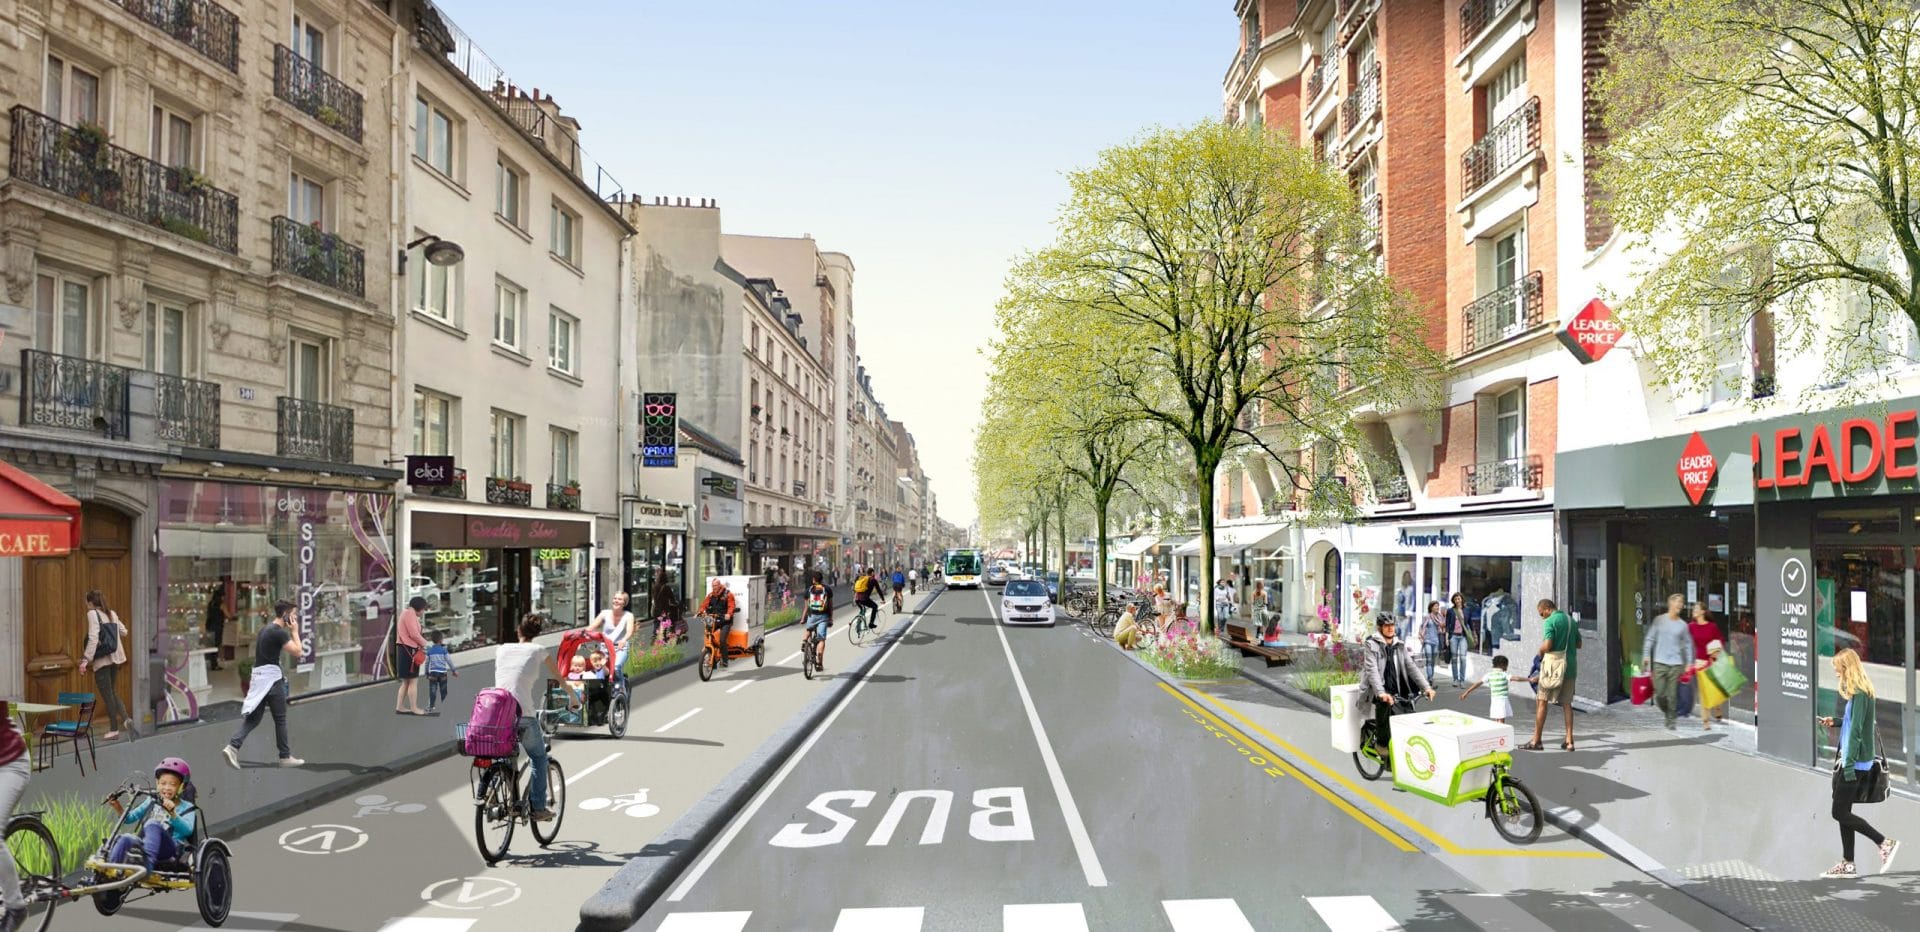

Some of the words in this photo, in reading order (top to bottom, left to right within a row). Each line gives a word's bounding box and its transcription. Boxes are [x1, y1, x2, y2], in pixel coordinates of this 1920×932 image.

[1578, 332, 1615, 344] PRICE
[1680, 455, 1713, 470] LEADER
[415, 462, 444, 478] eliot
[1683, 471, 1709, 485] PRICE
[278, 490, 306, 513] eliot
[471, 520, 520, 542] Quality
[527, 521, 558, 538] Shoes
[0, 533, 51, 553] CAFE
[436, 549, 481, 563] SOLDES
[539, 548, 571, 560] SOLDES
[301, 523, 313, 656] SOLDES
[1781, 603, 1807, 616] LUNDI
[1790, 616, 1799, 625] AU
[1781, 627, 1807, 638] SAMEDI
[768, 786, 1036, 849] BUS
